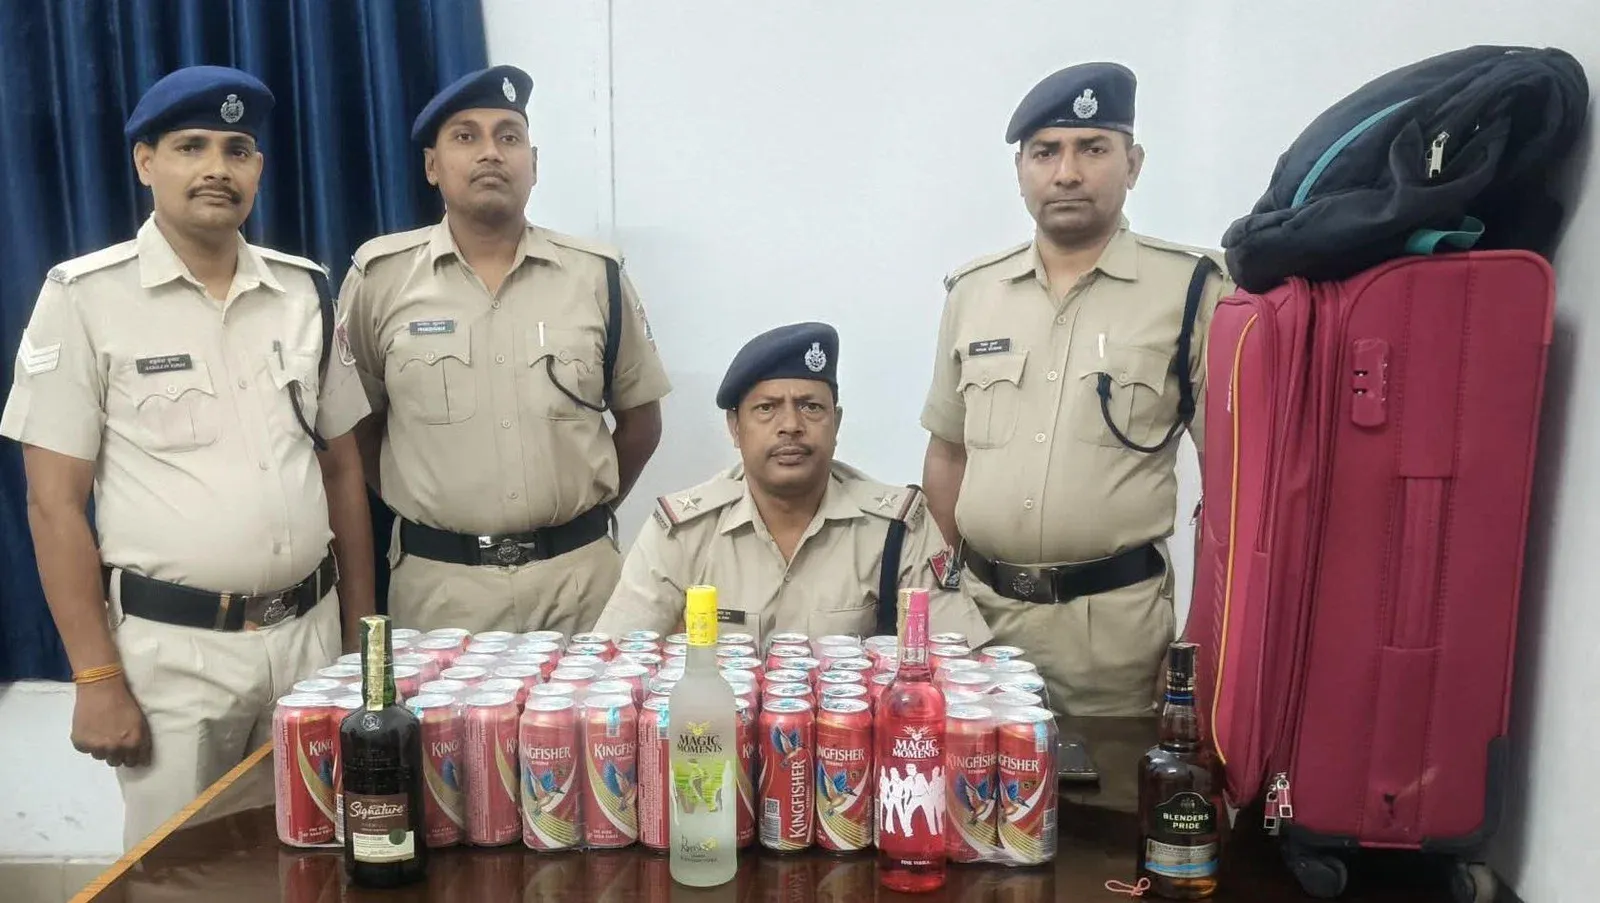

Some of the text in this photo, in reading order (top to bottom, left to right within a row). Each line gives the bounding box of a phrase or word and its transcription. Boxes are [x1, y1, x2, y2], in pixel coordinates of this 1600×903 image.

[680, 734, 719, 746] MAGIC
[895, 739, 938, 750] MAGIC
[677, 744, 723, 754] MOMENTS
[892, 748, 940, 759] MOMENTS
[789, 759, 807, 838] KINGFISHER
[350, 801, 403, 820] Signature
[1163, 812, 1209, 822] BLENDERS
